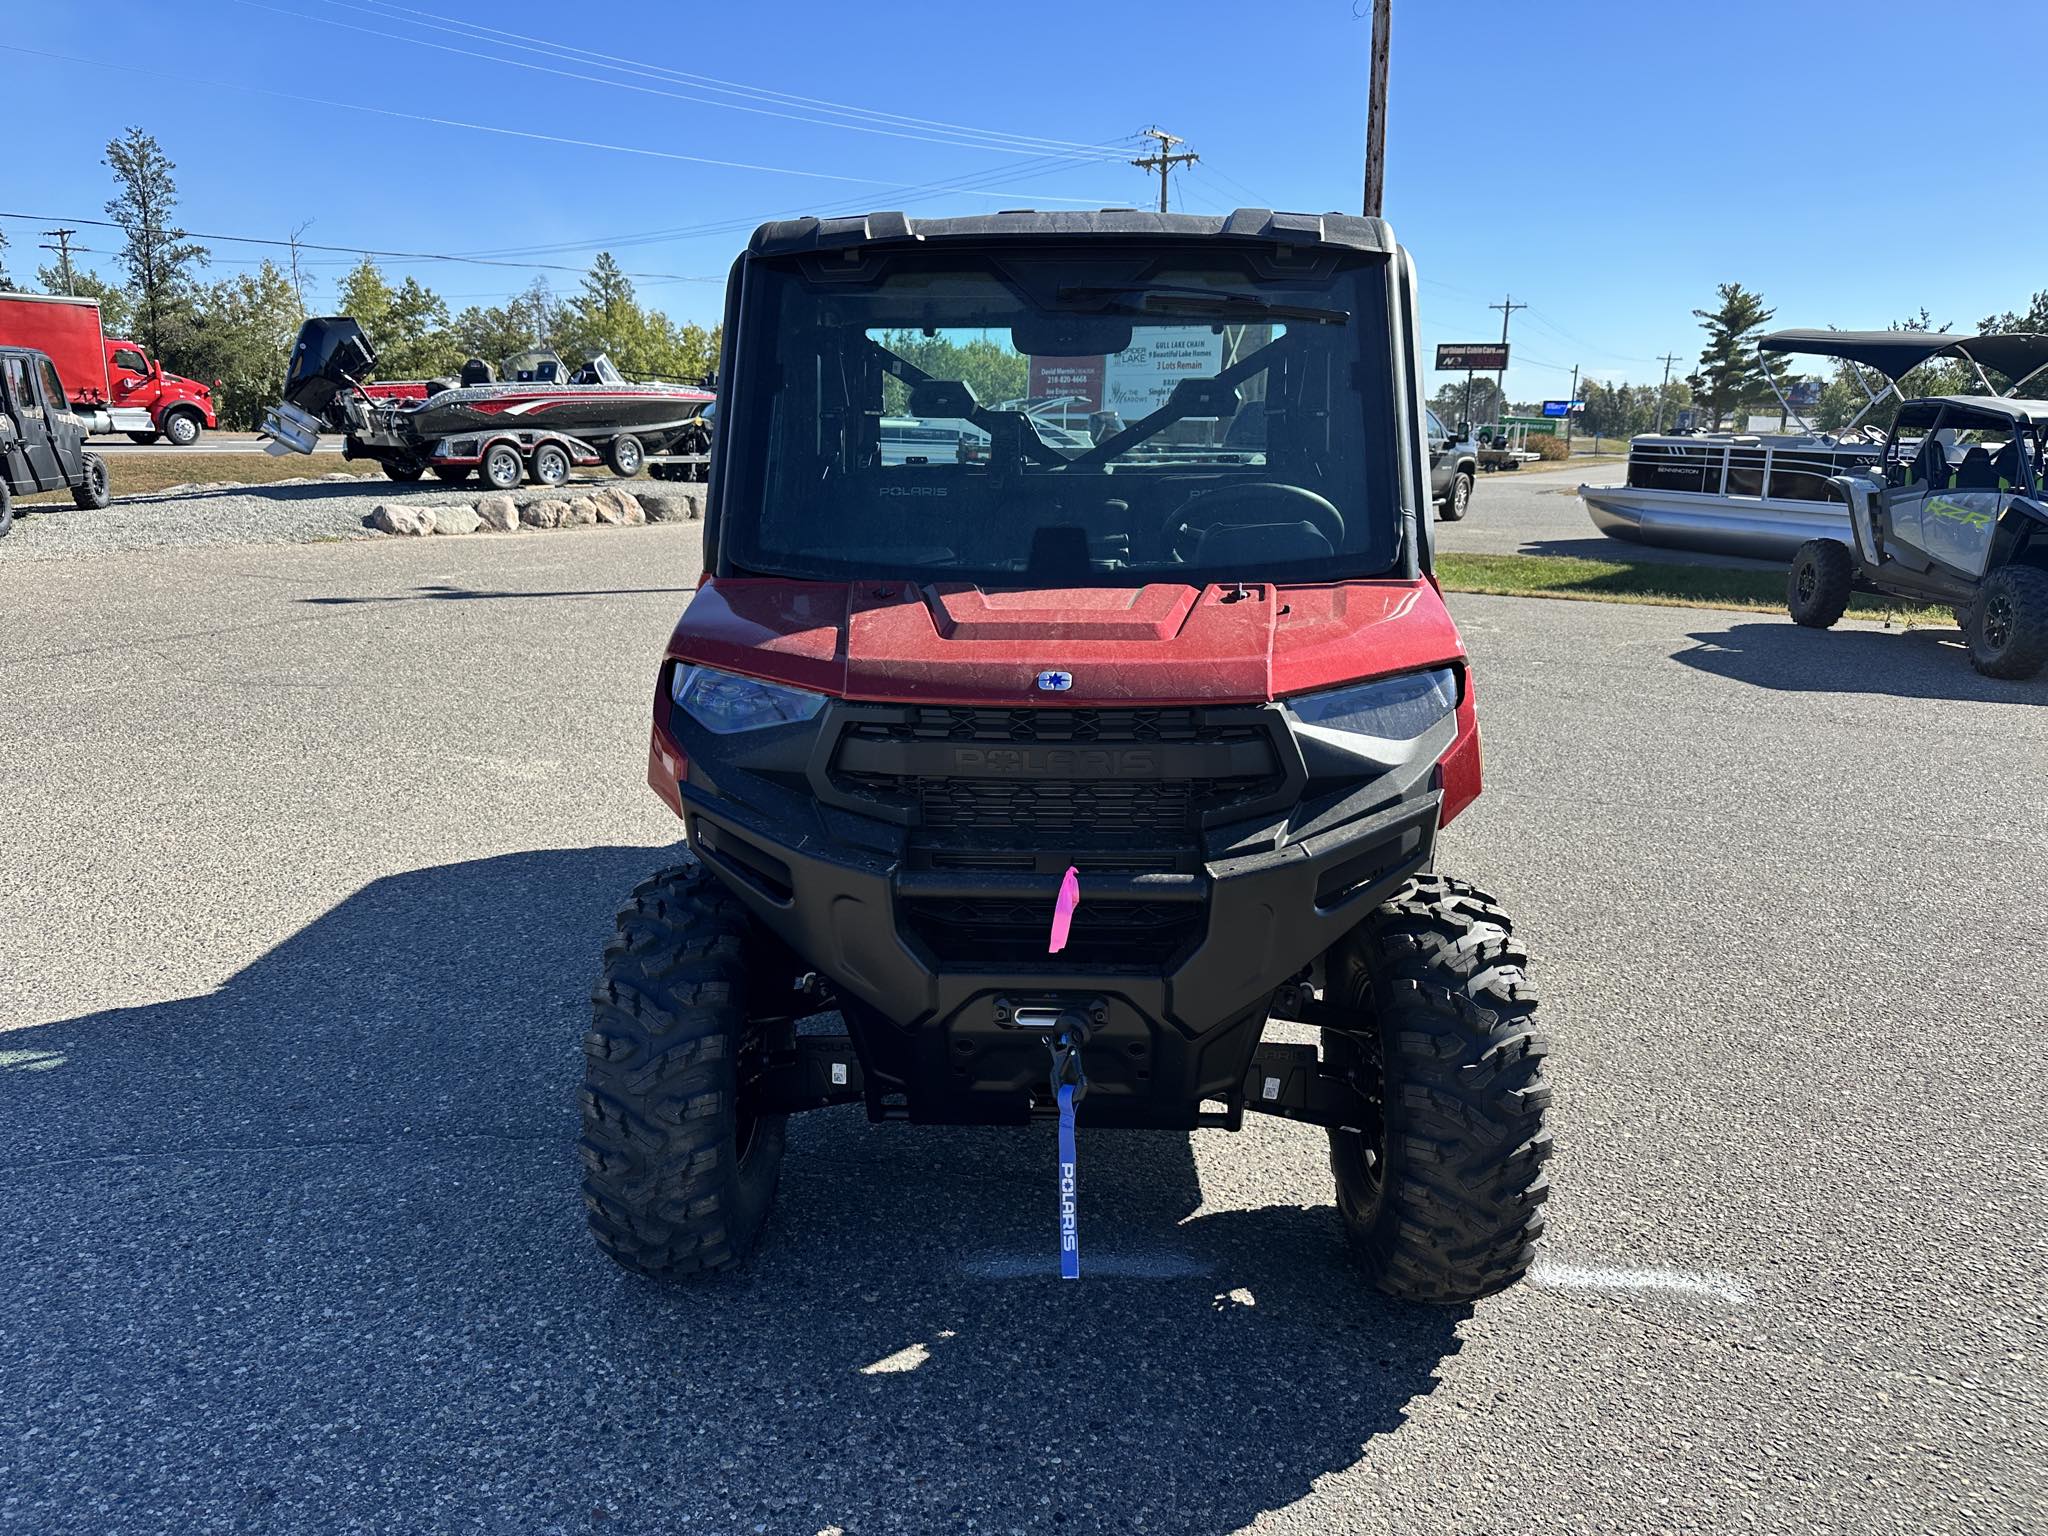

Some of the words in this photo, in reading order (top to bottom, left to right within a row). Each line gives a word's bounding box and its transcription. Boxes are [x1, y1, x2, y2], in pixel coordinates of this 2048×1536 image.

[1171, 341, 1185, 349] LAKE
[1186, 340, 1205, 348] CHAIN
[1122, 354, 1147, 363] LAKE
[1156, 361, 1161, 370] 3
[1162, 361, 1176, 369] Lots
[1176, 361, 1202, 369] Remain
[1041, 367, 1056, 375] David
[1046, 387, 1055, 395] Joe
[1148, 387, 1166, 397] Single
[1156, 398, 1160, 407] 7
[1657, 466, 1699, 475] BENNINGTON
[879, 486, 948, 497] POLARIS
[954, 749, 1154, 776] POLARIS
[1061, 1162, 1076, 1252] POLARIS
